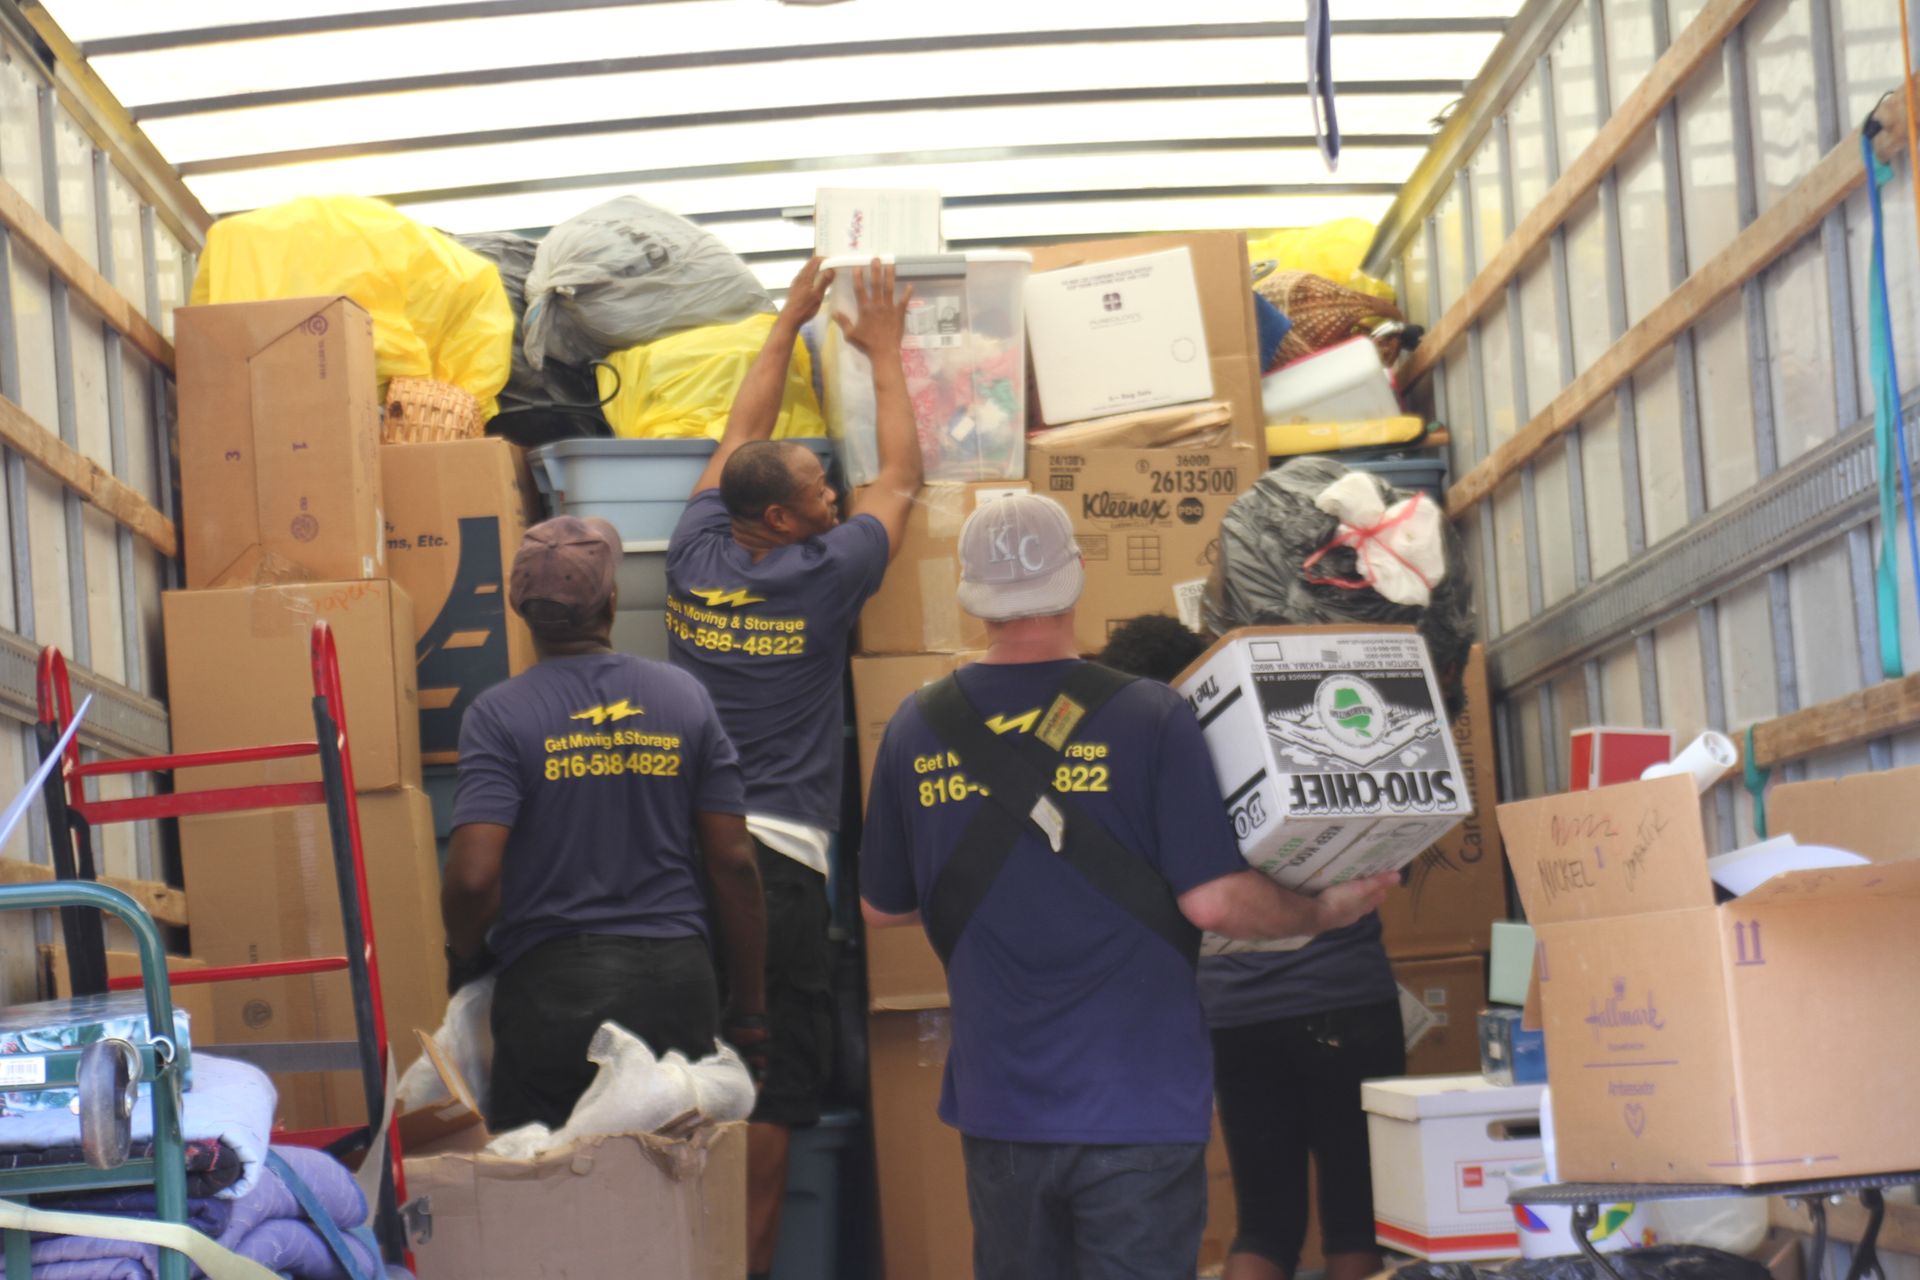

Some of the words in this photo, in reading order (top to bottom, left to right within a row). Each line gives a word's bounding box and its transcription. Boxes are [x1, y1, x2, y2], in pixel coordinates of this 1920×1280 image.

[1082, 490, 1170, 525] Kleenex
[417, 535, 448, 548] Etc.
[988, 520, 1044, 572] KC
[667, 595, 681, 613] Get
[683, 604, 727, 629] Moving
[730, 616, 740, 629] &
[744, 617, 805, 633] Storage
[545, 737, 569, 753] Get
[614, 731, 625, 746] &
[625, 731, 680, 750] Storage
[914, 754, 943, 774] Get
